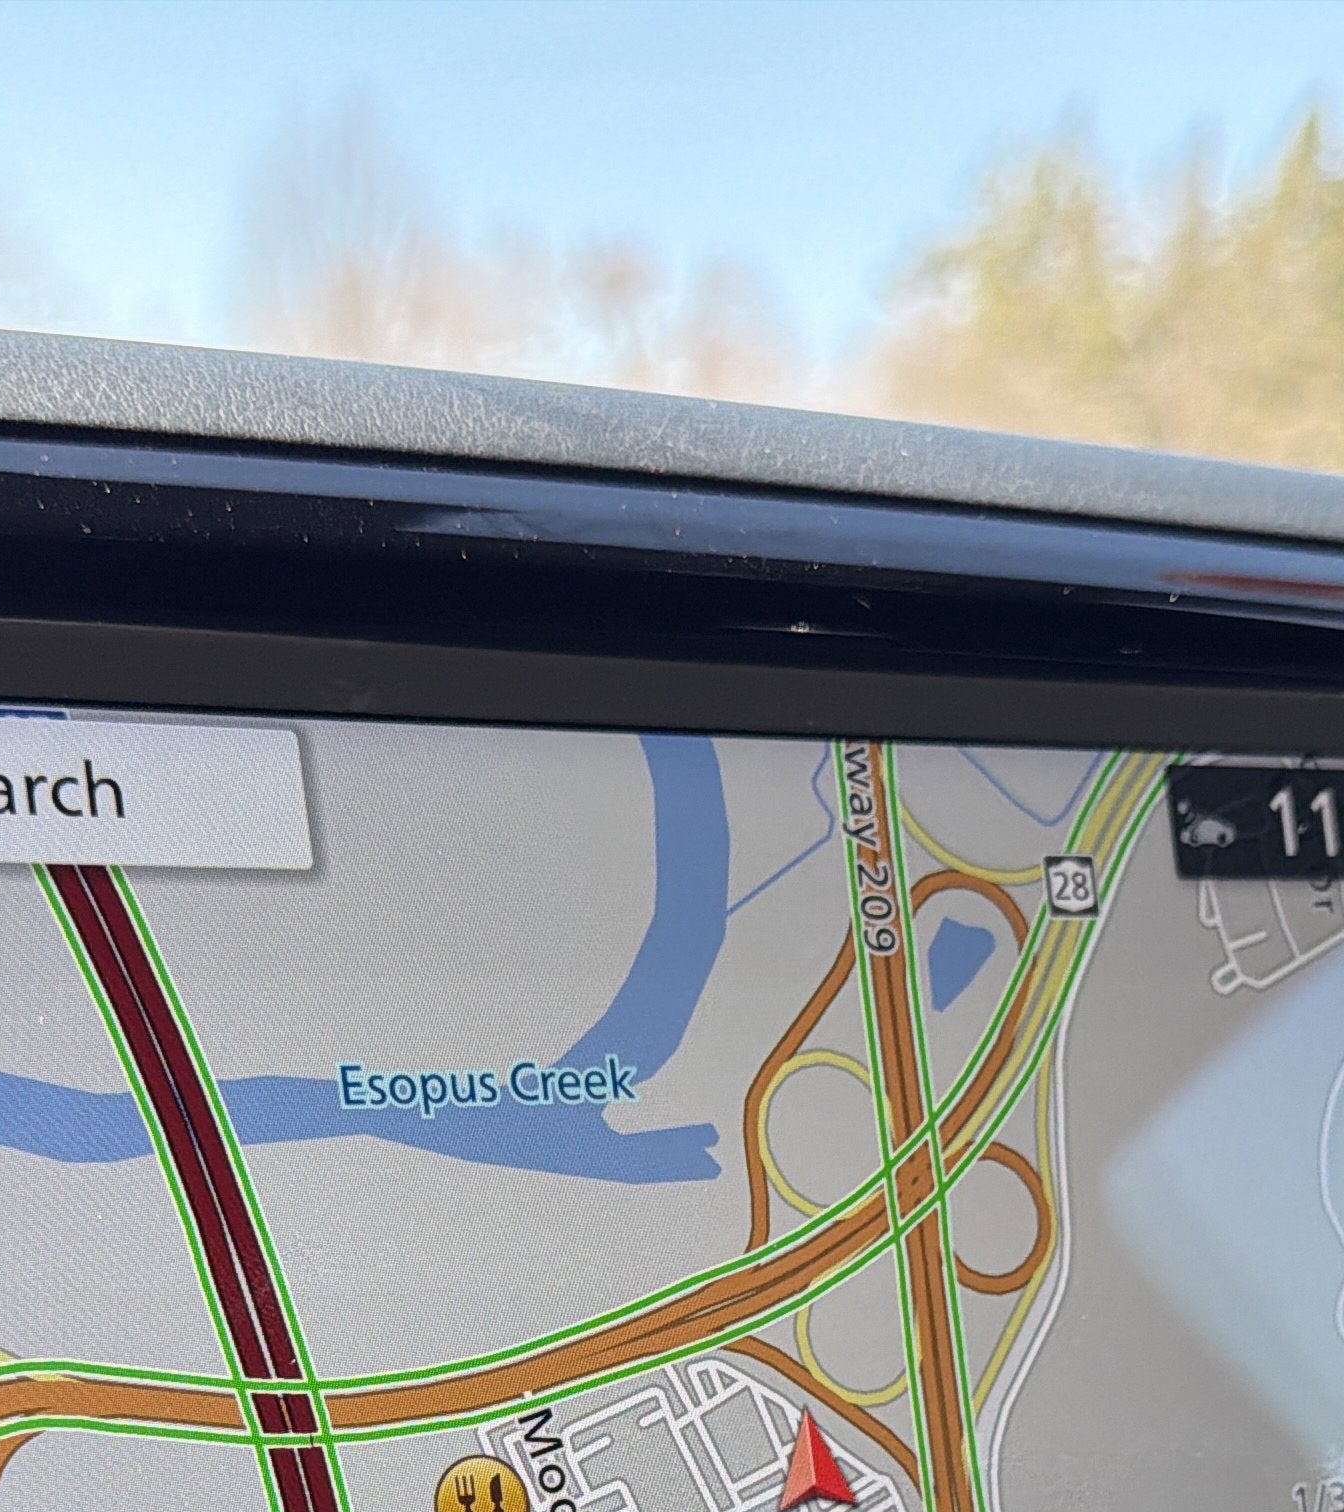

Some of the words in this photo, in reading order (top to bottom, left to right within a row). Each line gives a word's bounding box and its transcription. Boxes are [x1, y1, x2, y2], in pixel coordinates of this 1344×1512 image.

[857, 863, 896, 952] 209
[1053, 871, 1090, 902] 28
[340, 1064, 498, 1115] Esopus
[511, 1057, 636, 1102] Creek
